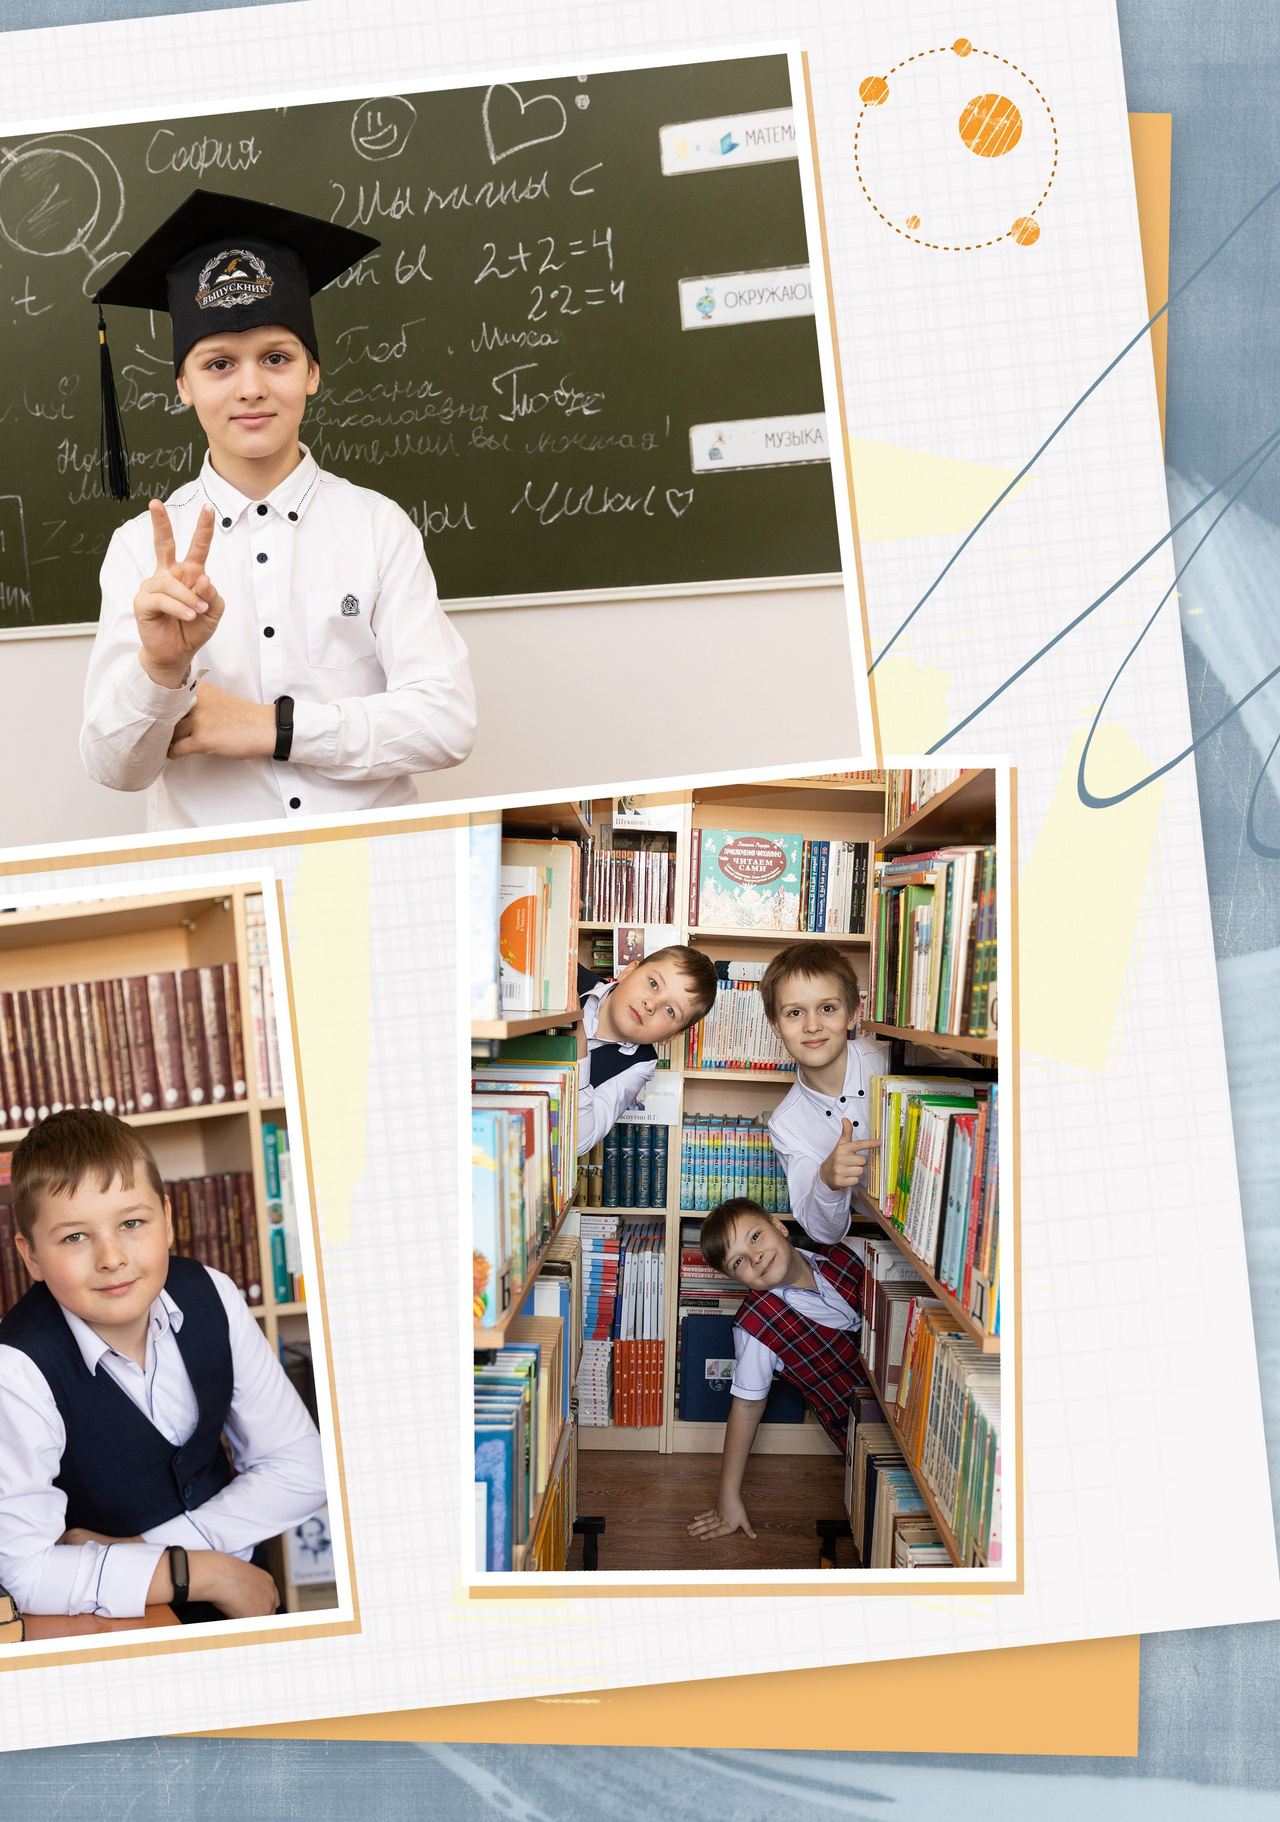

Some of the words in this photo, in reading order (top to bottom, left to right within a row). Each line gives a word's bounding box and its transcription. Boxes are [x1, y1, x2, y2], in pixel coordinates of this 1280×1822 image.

[202, 283, 269, 307] ВЫПУСКНИК
[764, 428, 824, 449] МУЗЫКА
[733, 858, 773, 866] ЧИТАЕМ
[971, 1279, 985, 1327] Д
